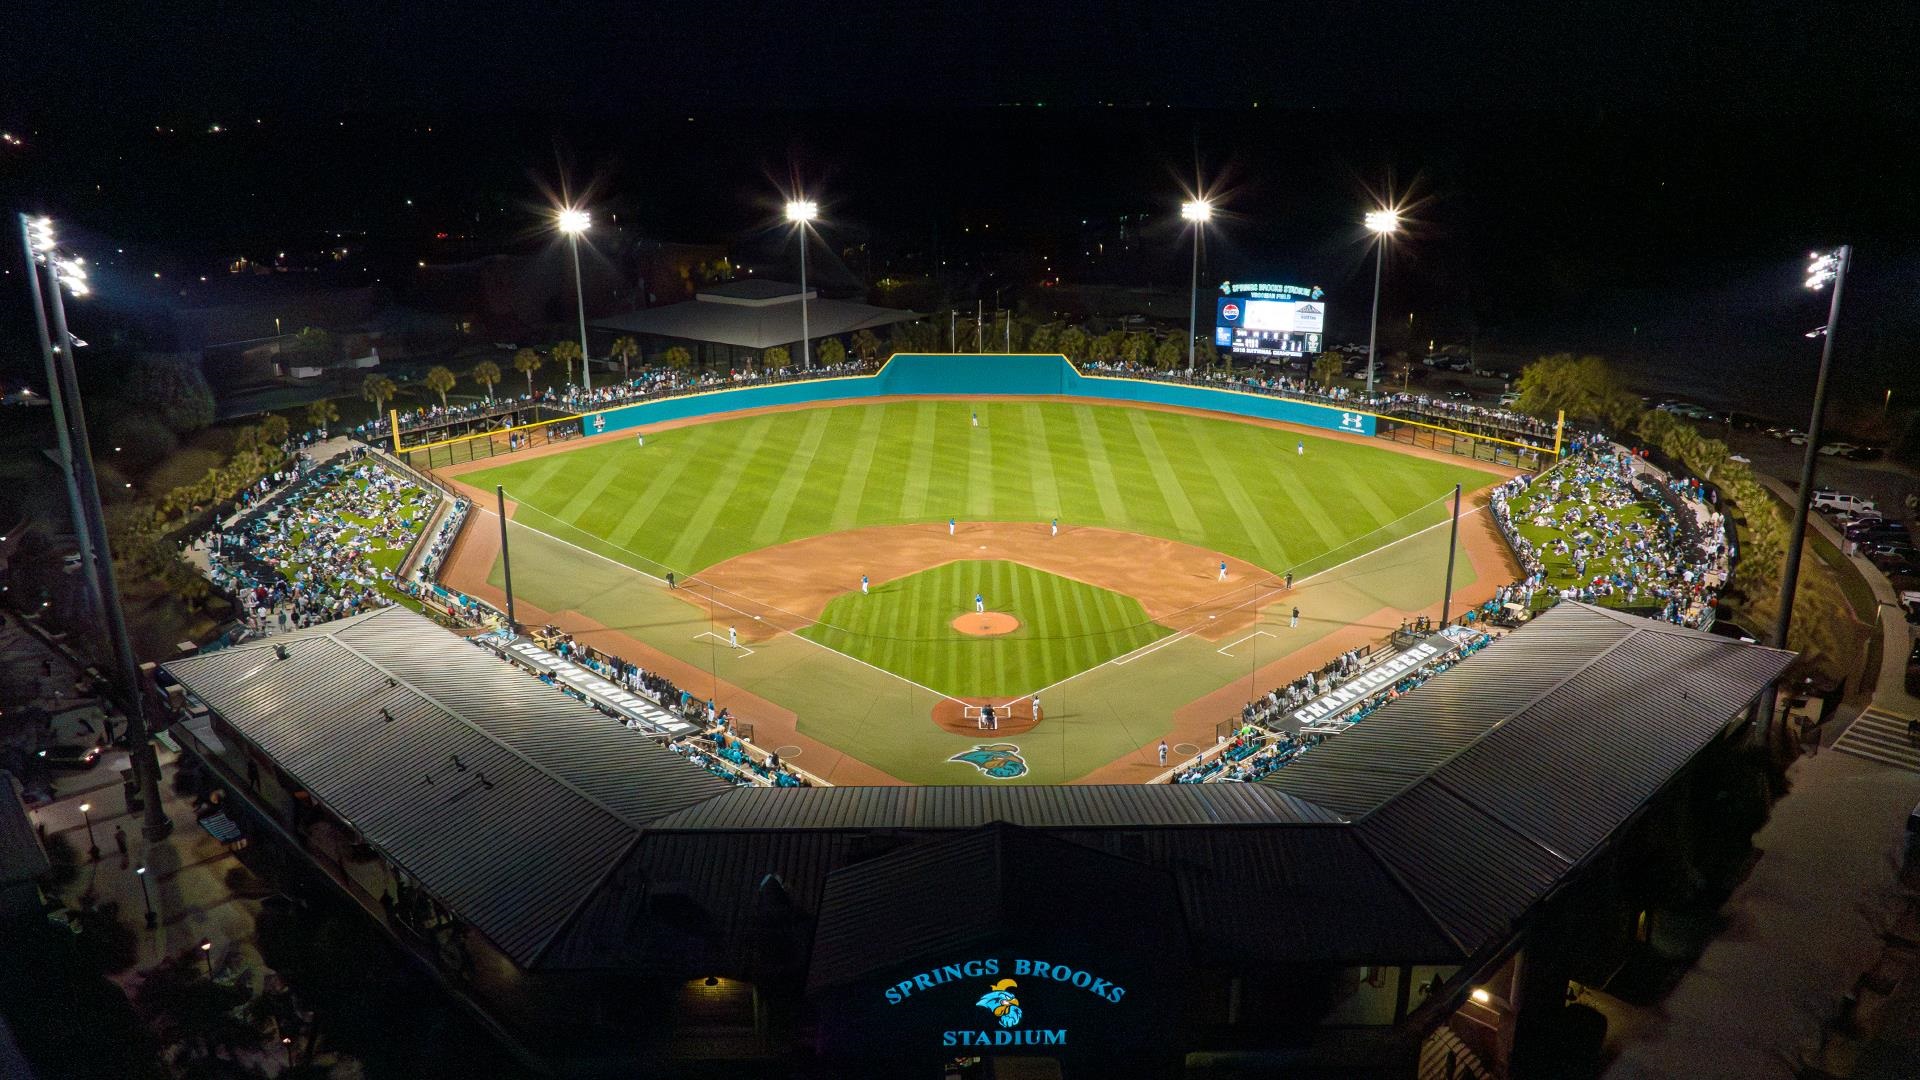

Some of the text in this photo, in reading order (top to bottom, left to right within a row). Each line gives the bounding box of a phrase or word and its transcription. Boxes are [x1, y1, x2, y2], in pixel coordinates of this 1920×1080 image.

[511, 643, 690, 732] COASTAL CAROLINA
[1294, 643, 1438, 723] CHANTICLEERS
[885, 959, 1126, 1005] SPRINGS BROOKS
[943, 1029, 1068, 1046] STADIUM
